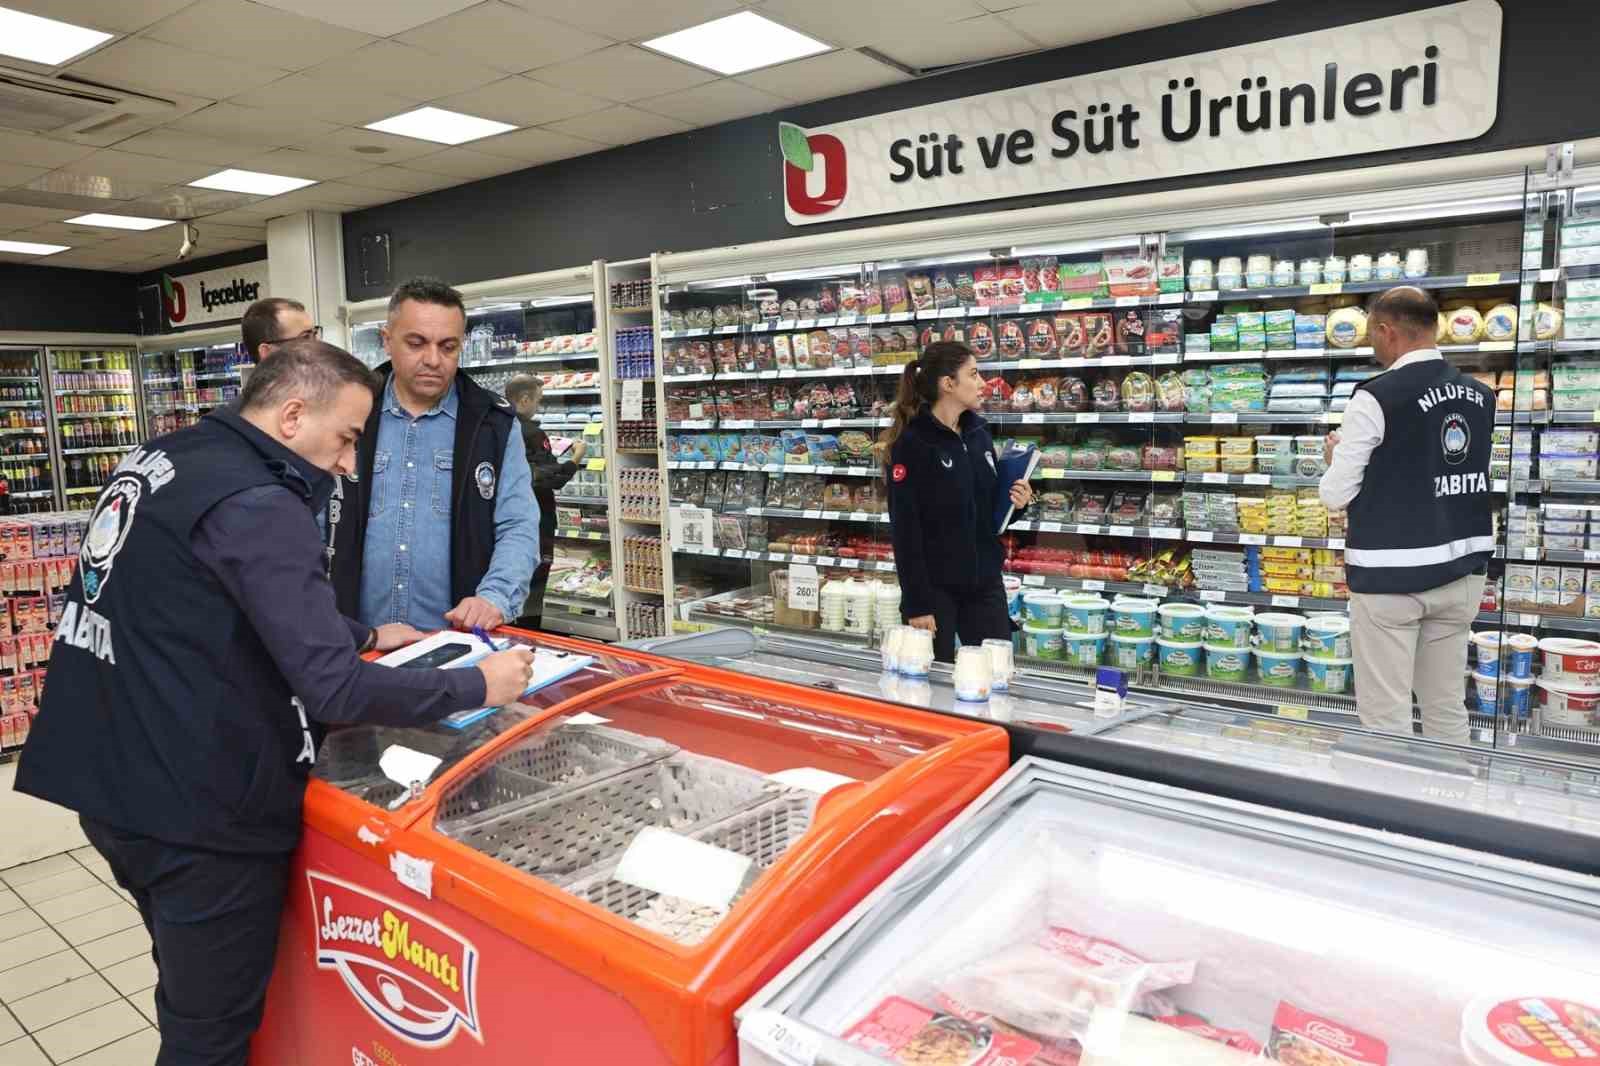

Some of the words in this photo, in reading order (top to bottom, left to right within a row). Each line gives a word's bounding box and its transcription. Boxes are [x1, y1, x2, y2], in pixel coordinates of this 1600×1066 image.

[890, 134, 963, 183] Süt
[978, 129, 1034, 169] ve
[1051, 102, 1140, 159] Süt
[1161, 45, 1438, 142] Ürünleri
[200, 280, 260, 312] İçecekler
[1417, 382, 1484, 412] NİLÜFER
[1434, 472, 1487, 497] ZABITA
[56, 601, 116, 665] ABITA
